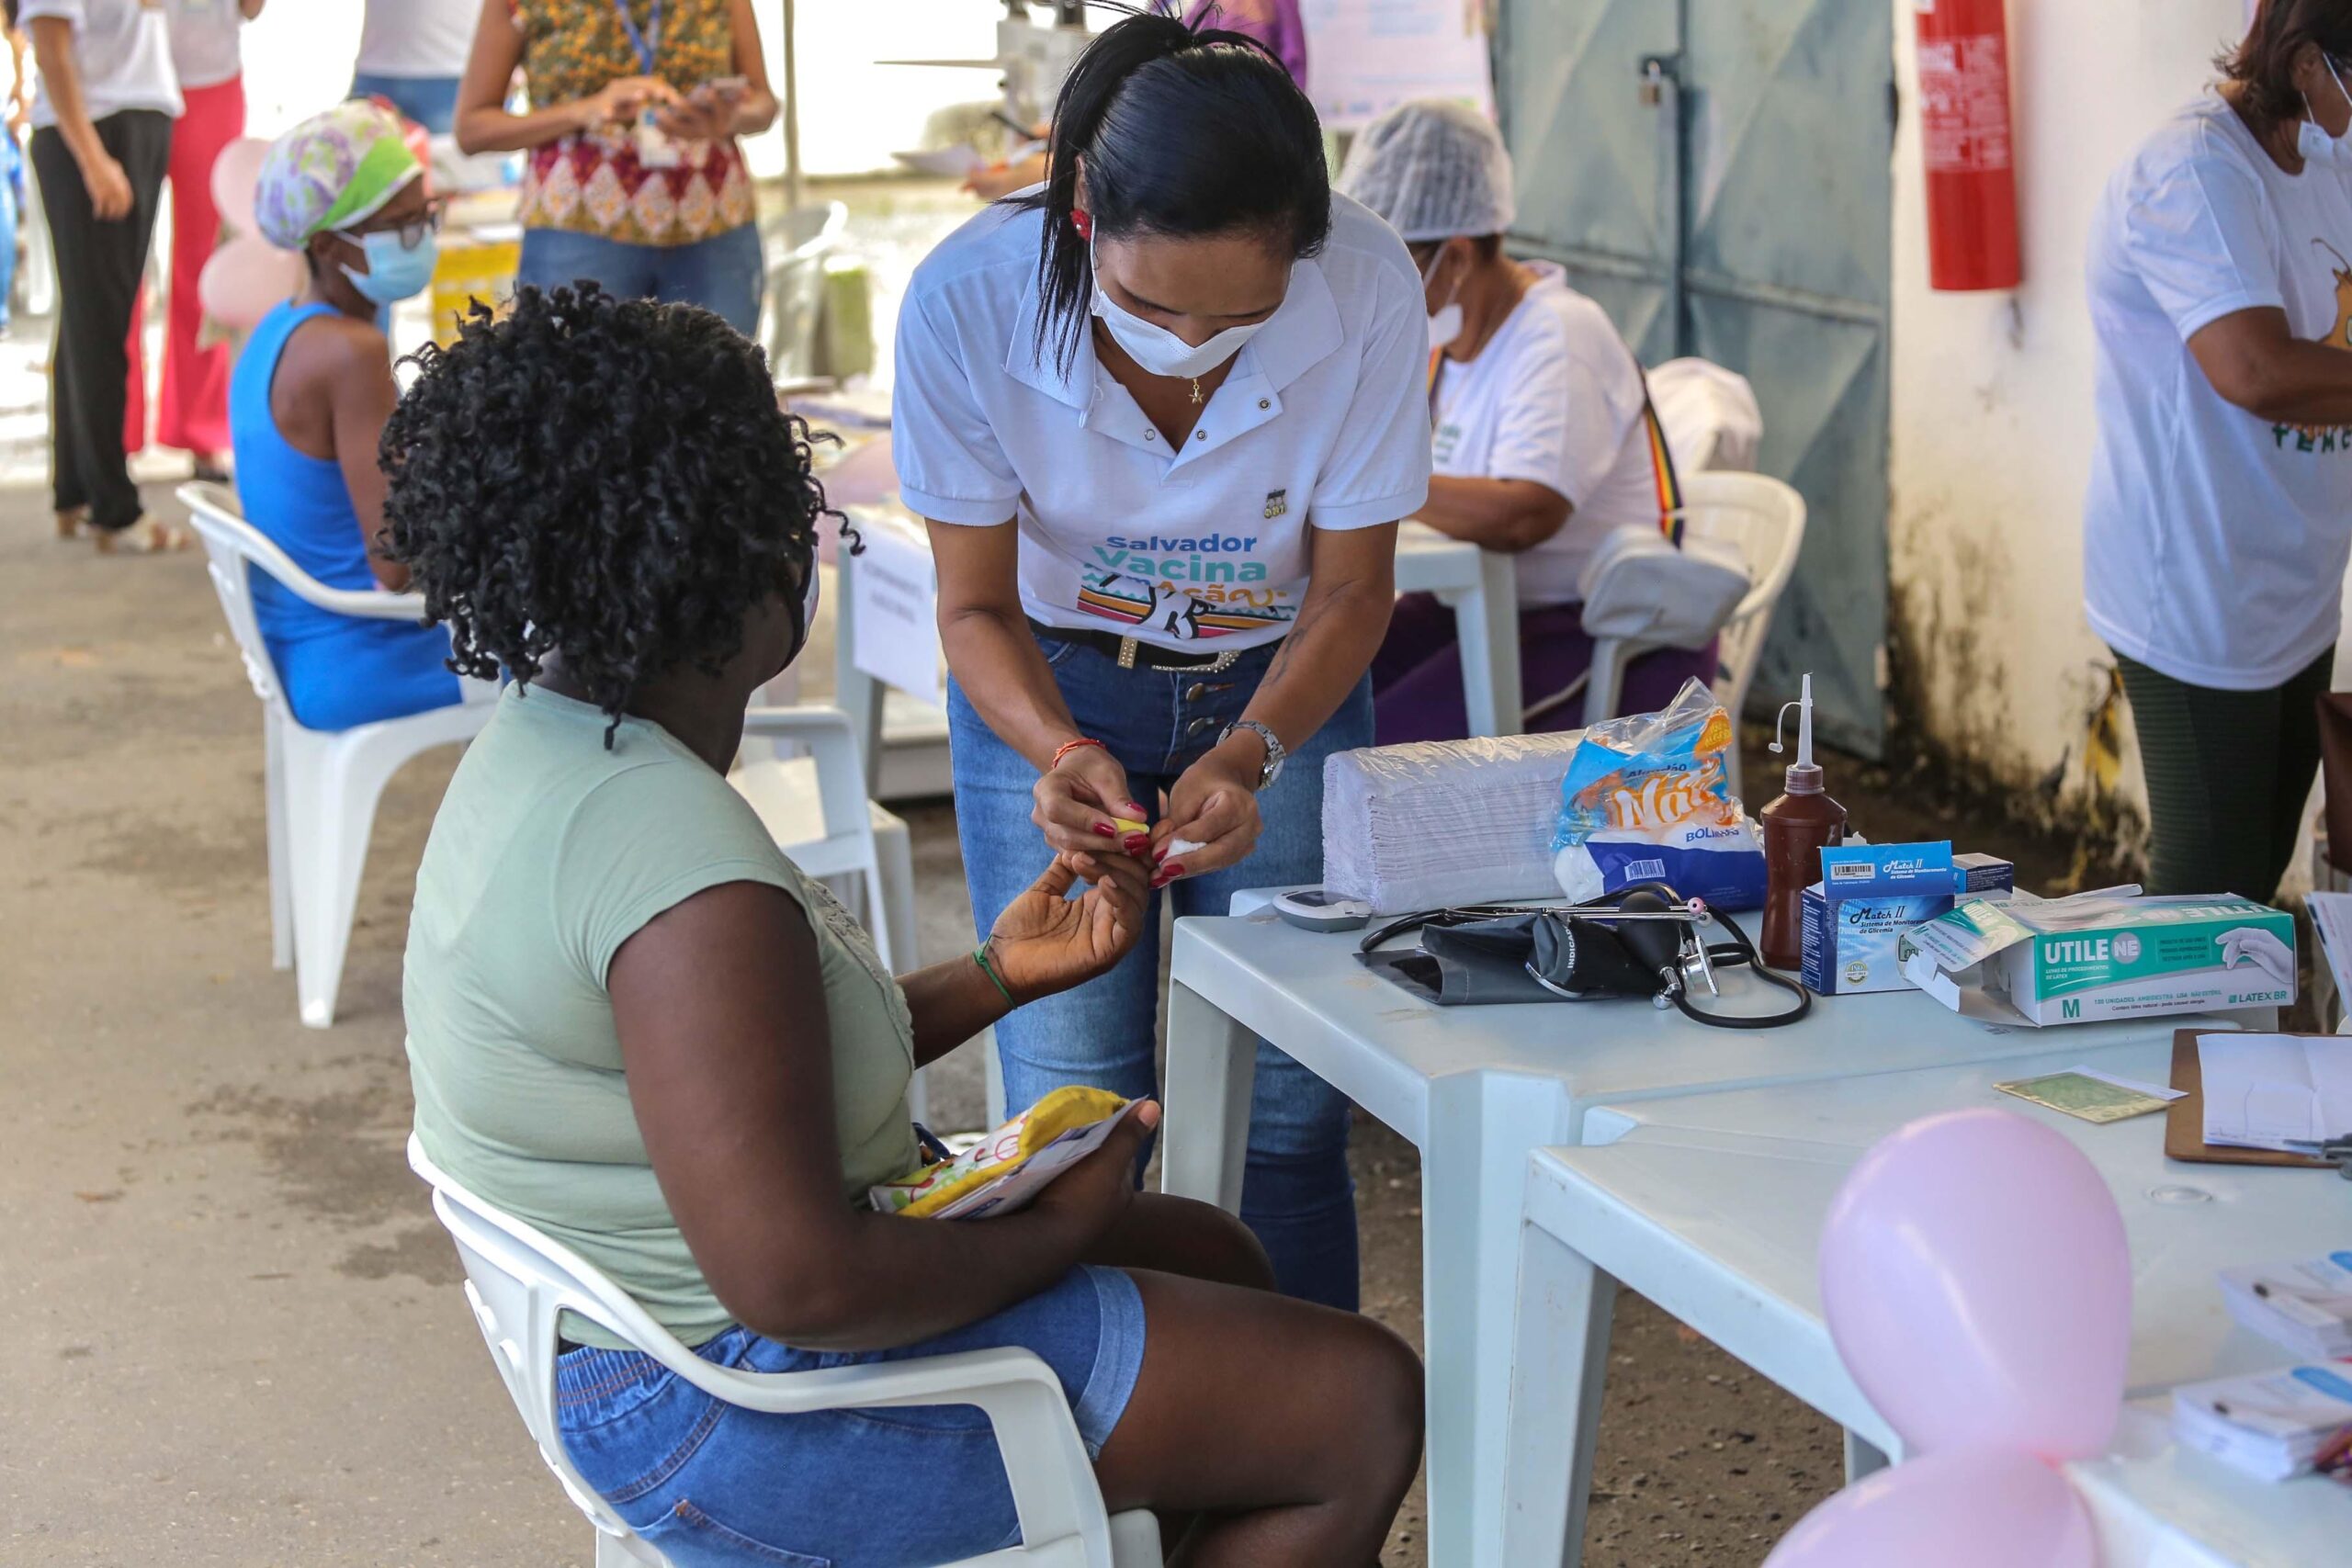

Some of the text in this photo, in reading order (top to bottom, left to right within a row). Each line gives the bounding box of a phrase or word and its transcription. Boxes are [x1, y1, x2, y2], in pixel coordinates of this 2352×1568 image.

[1105, 533, 1257, 553] Salvador
[1091, 544, 1267, 583] Vacina
[1883, 860, 1914, 873] Match
[1849, 906, 1906, 924] Match II
[1562, 924, 1576, 969] INDICAD
[2044, 939, 2139, 964] UTILE NE
[2239, 991, 2287, 1003] LATEX BR
[2062, 998, 2080, 1019] M
